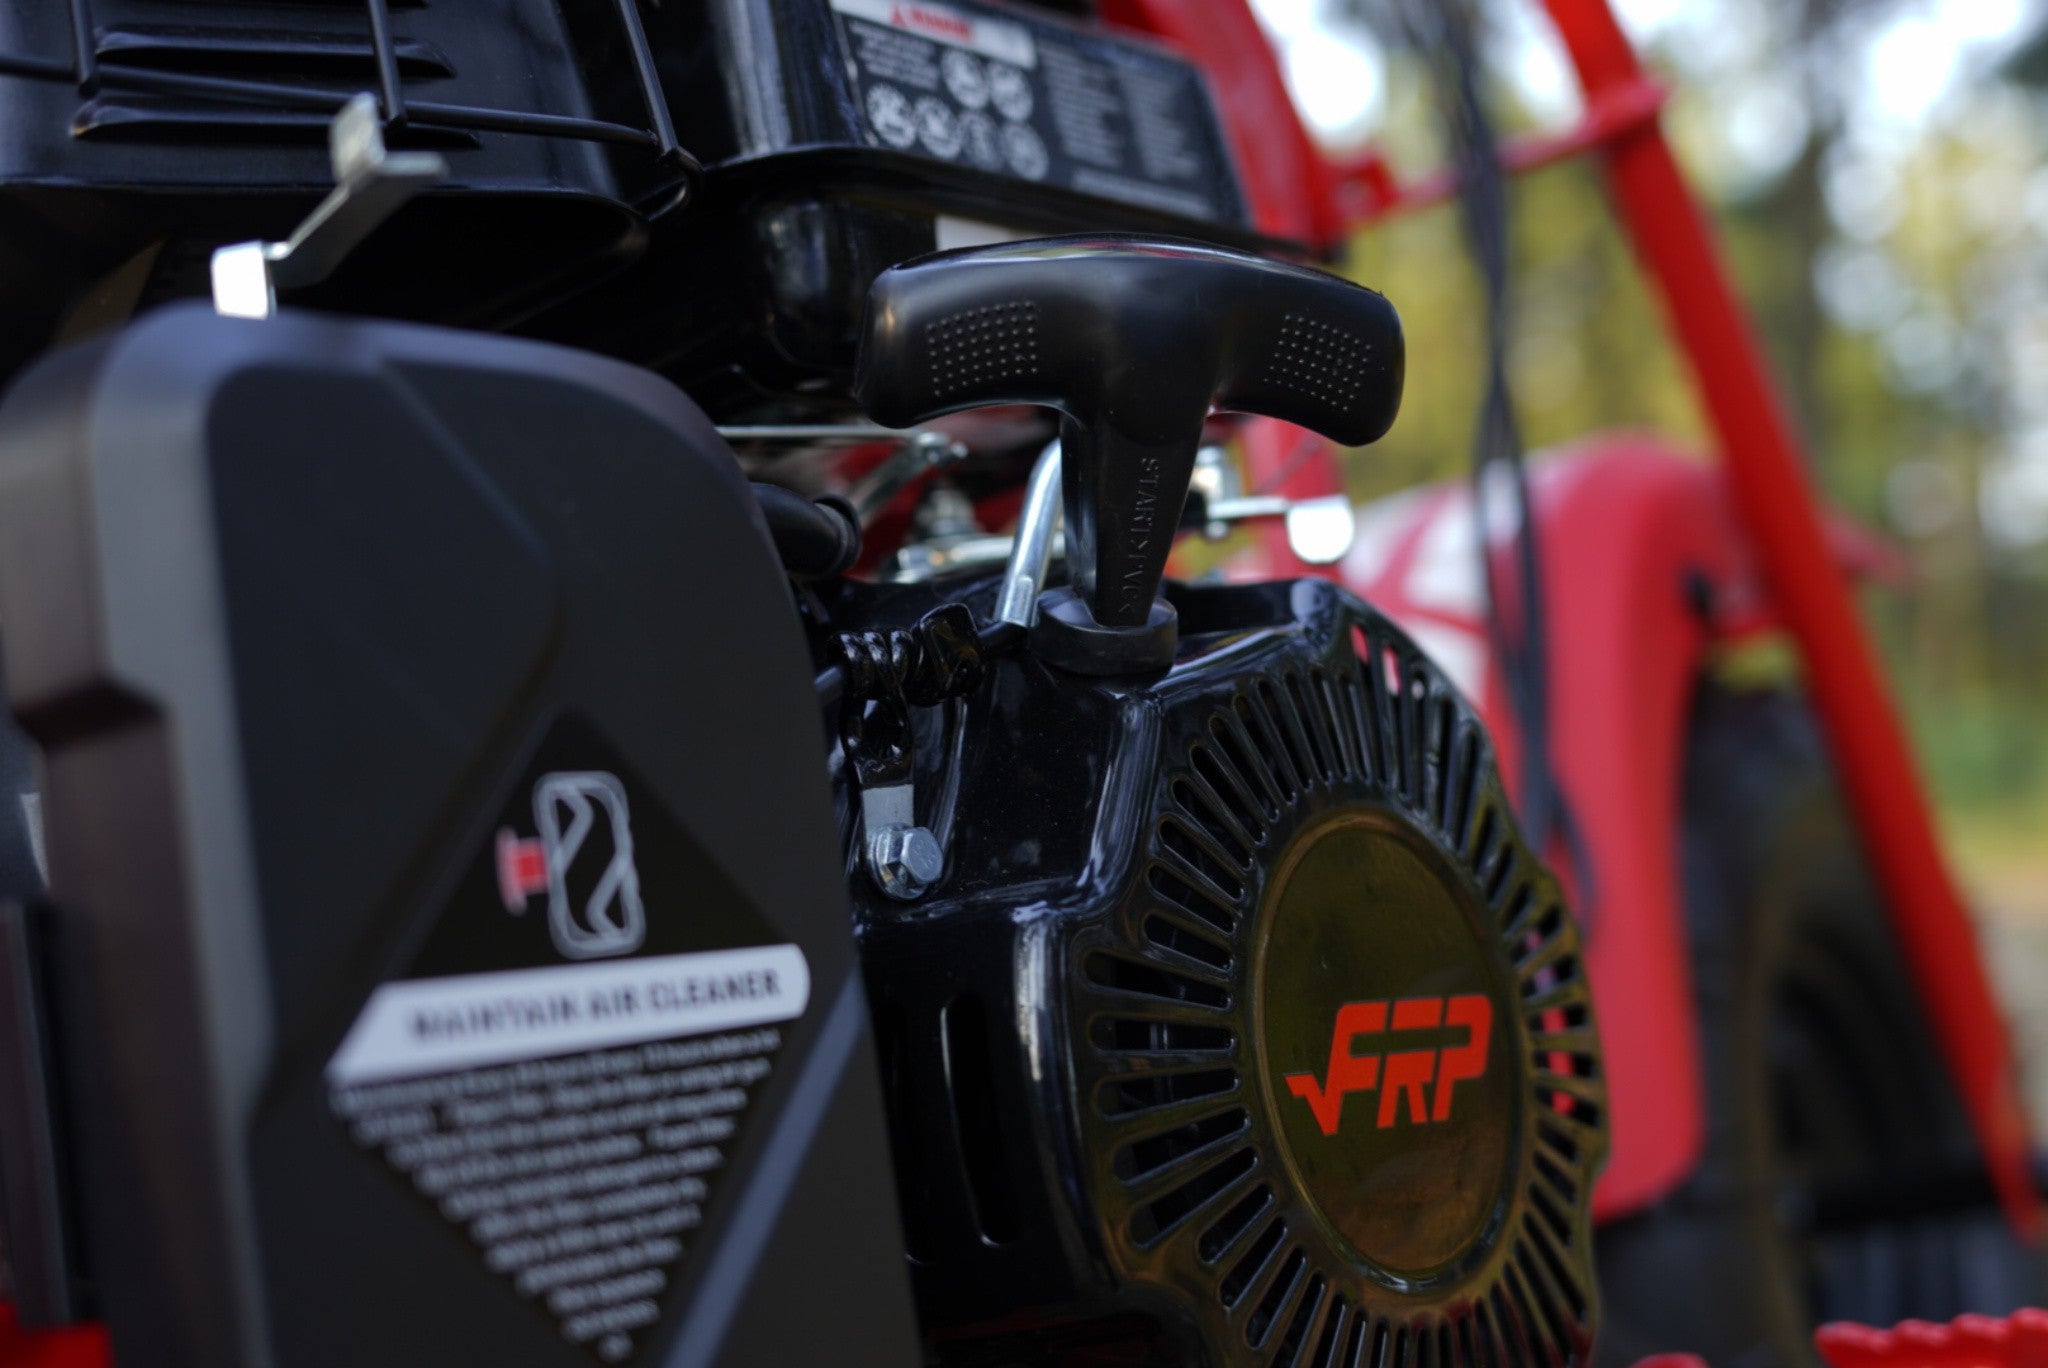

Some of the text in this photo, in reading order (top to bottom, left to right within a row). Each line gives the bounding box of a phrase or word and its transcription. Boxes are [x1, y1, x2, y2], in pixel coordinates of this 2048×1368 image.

[413, 967, 782, 1039] MAINTAIN AIR CLEANER
[1283, 994, 1494, 1136] FRP
